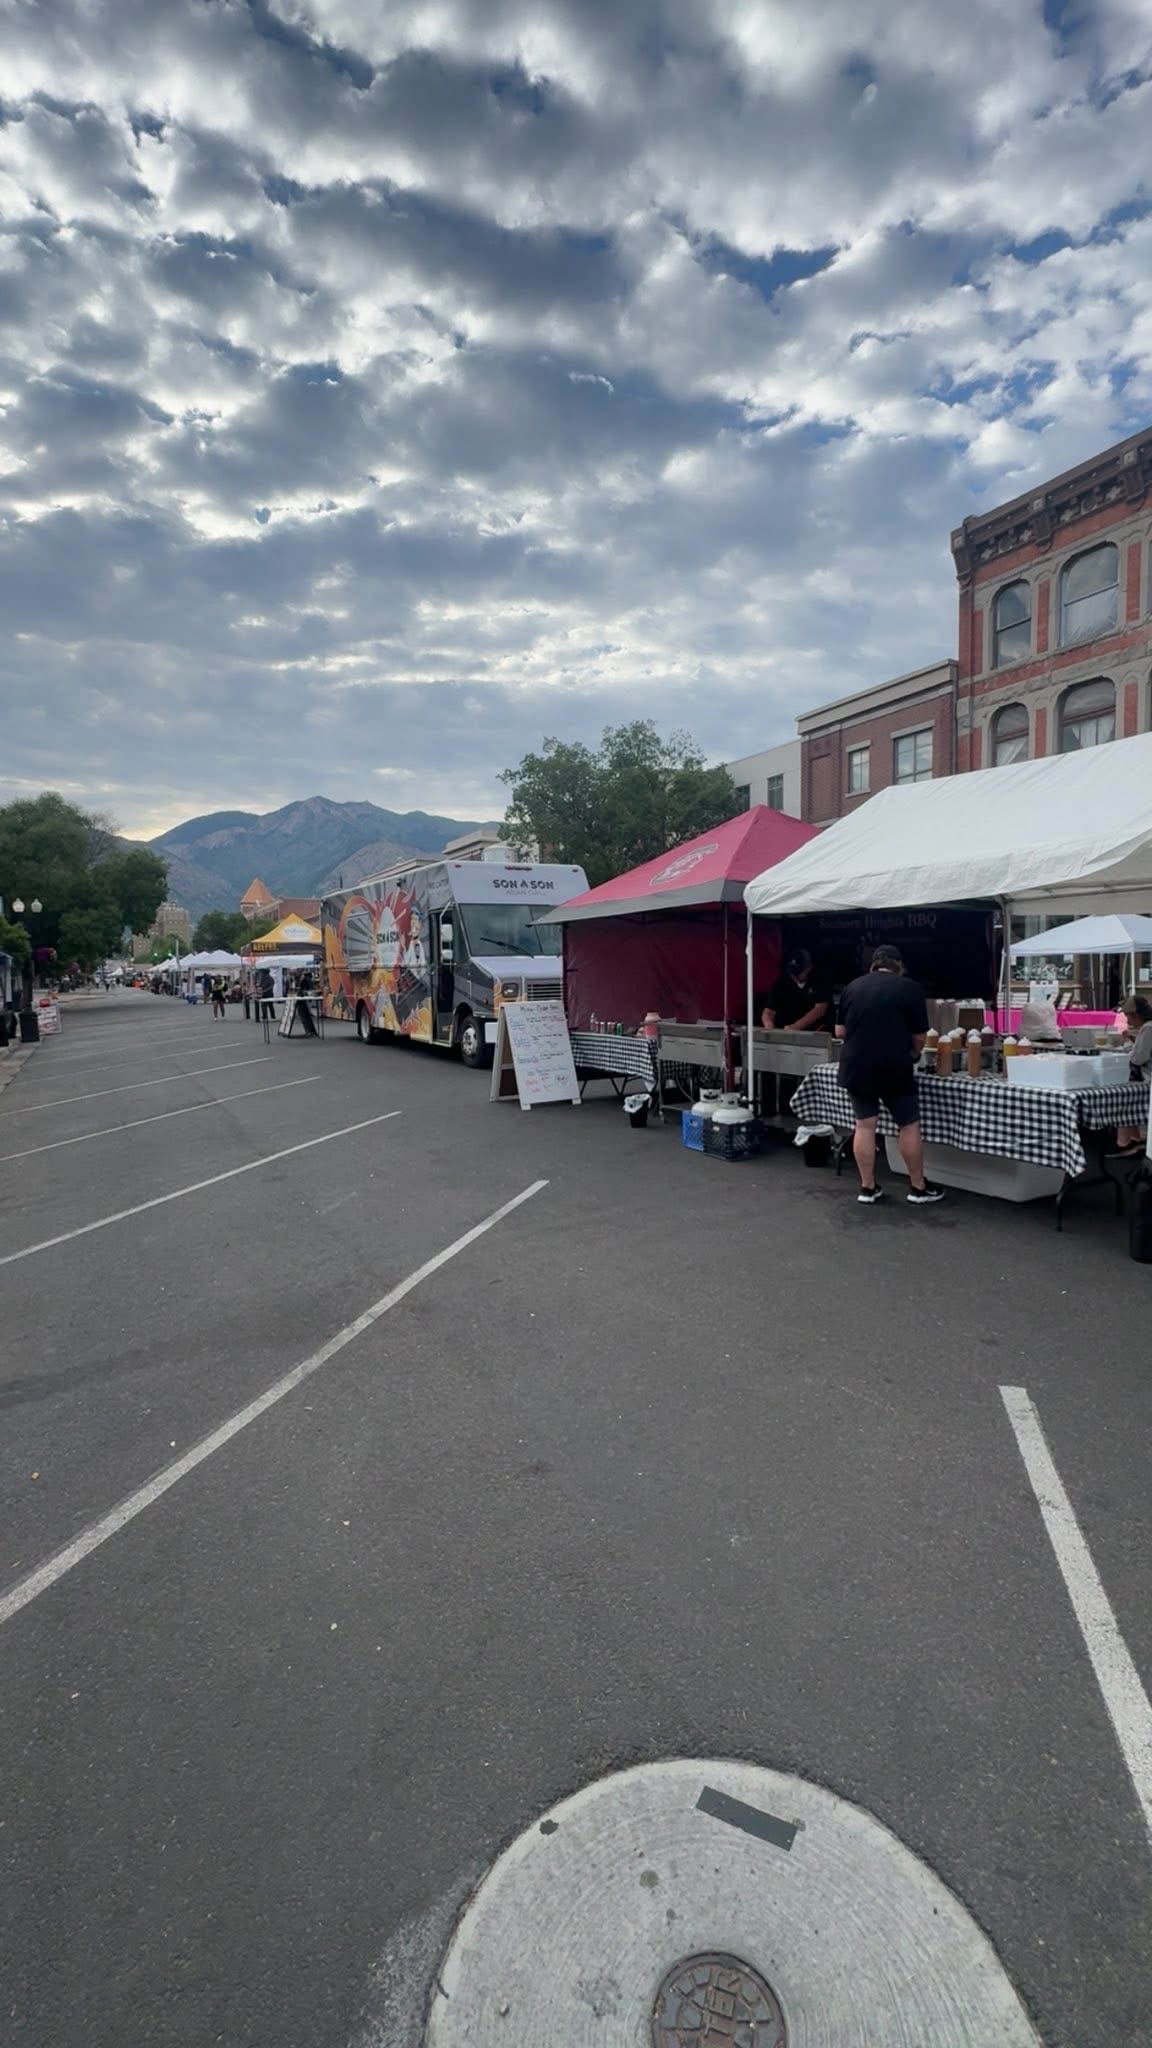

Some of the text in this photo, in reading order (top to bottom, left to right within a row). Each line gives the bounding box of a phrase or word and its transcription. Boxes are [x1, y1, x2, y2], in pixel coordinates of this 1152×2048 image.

[492, 879, 518, 889] SON
[530, 880, 555, 890] SON
[907, 911, 937, 929] BBQ
